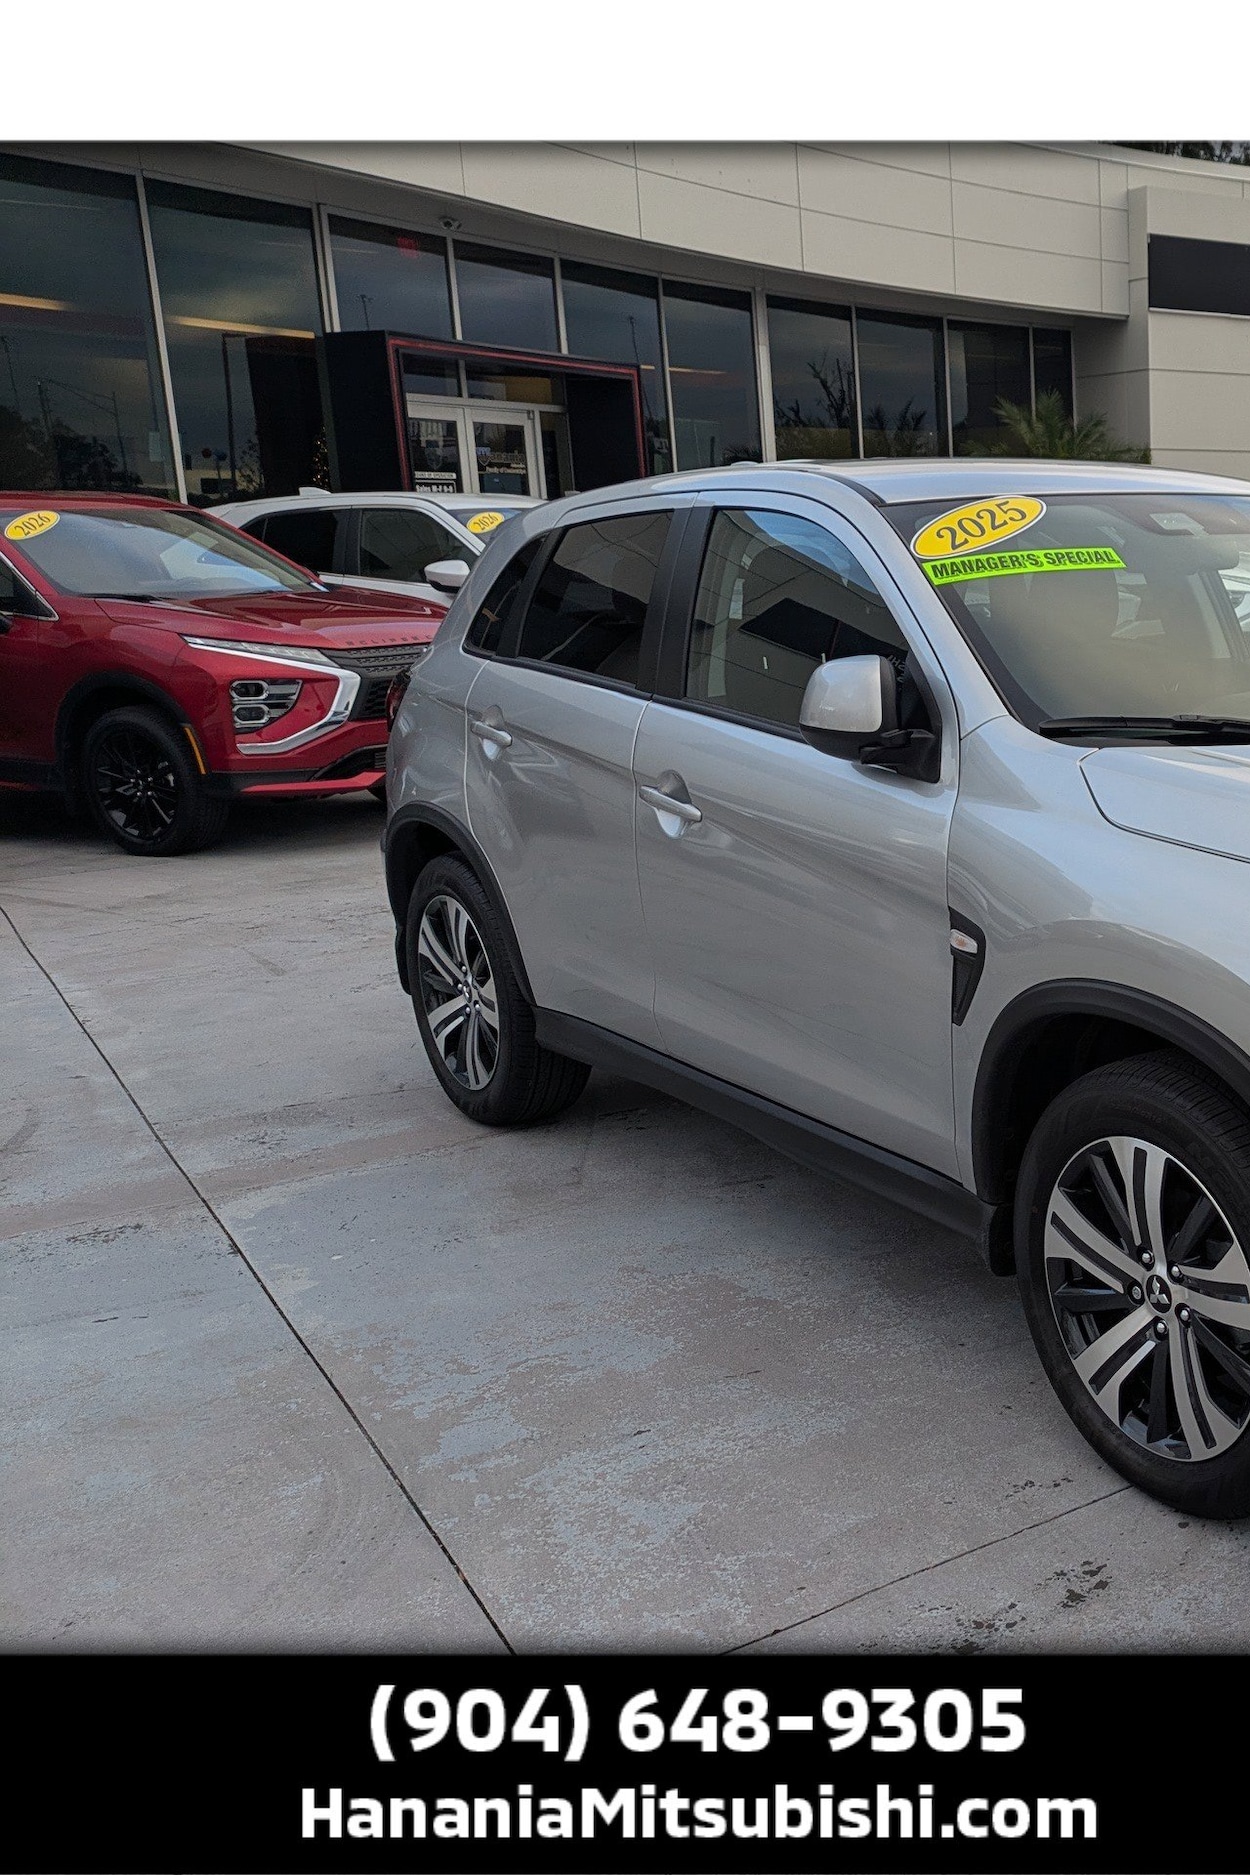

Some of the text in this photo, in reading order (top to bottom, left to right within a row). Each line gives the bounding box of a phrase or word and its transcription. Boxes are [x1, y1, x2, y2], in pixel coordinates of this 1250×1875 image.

[14, 512, 51, 537] 2026
[936, 499, 1027, 551] 2025
[931, 549, 1118, 580] MANAGER'S SPECIAL
